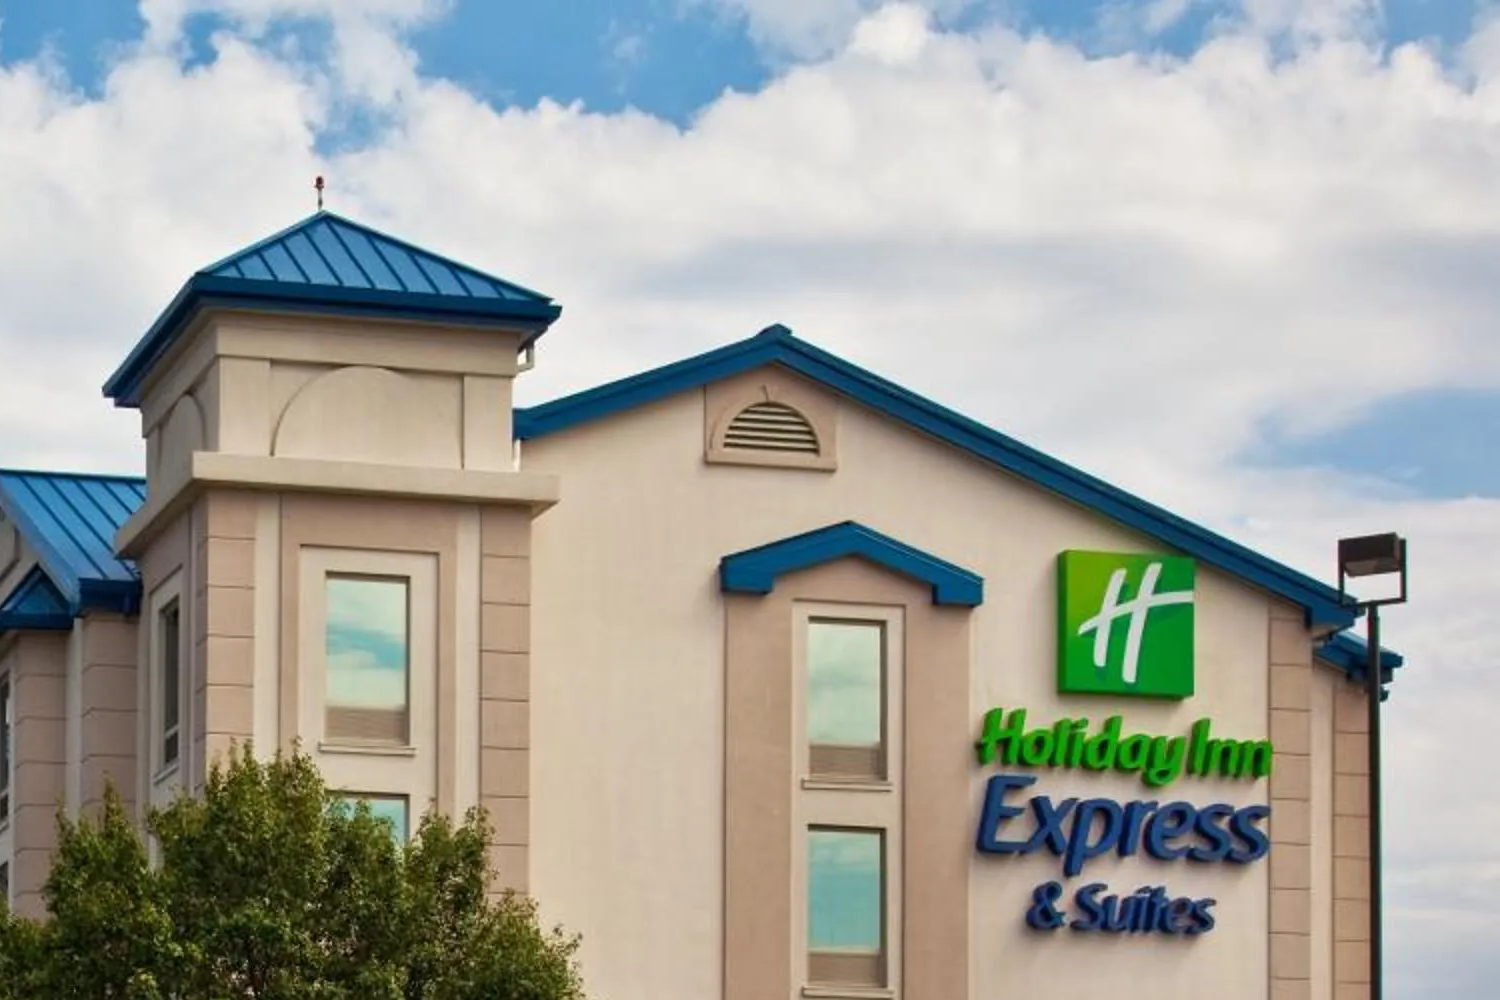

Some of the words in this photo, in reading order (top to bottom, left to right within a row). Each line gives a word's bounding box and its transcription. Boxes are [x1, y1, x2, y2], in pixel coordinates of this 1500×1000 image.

[975, 707, 1187, 787] Holiday
[1187, 717, 1274, 780] Inn
[975, 773, 1271, 878] Express
[1025, 880, 1066, 932] &
[1070, 883, 1217, 935] Suites
